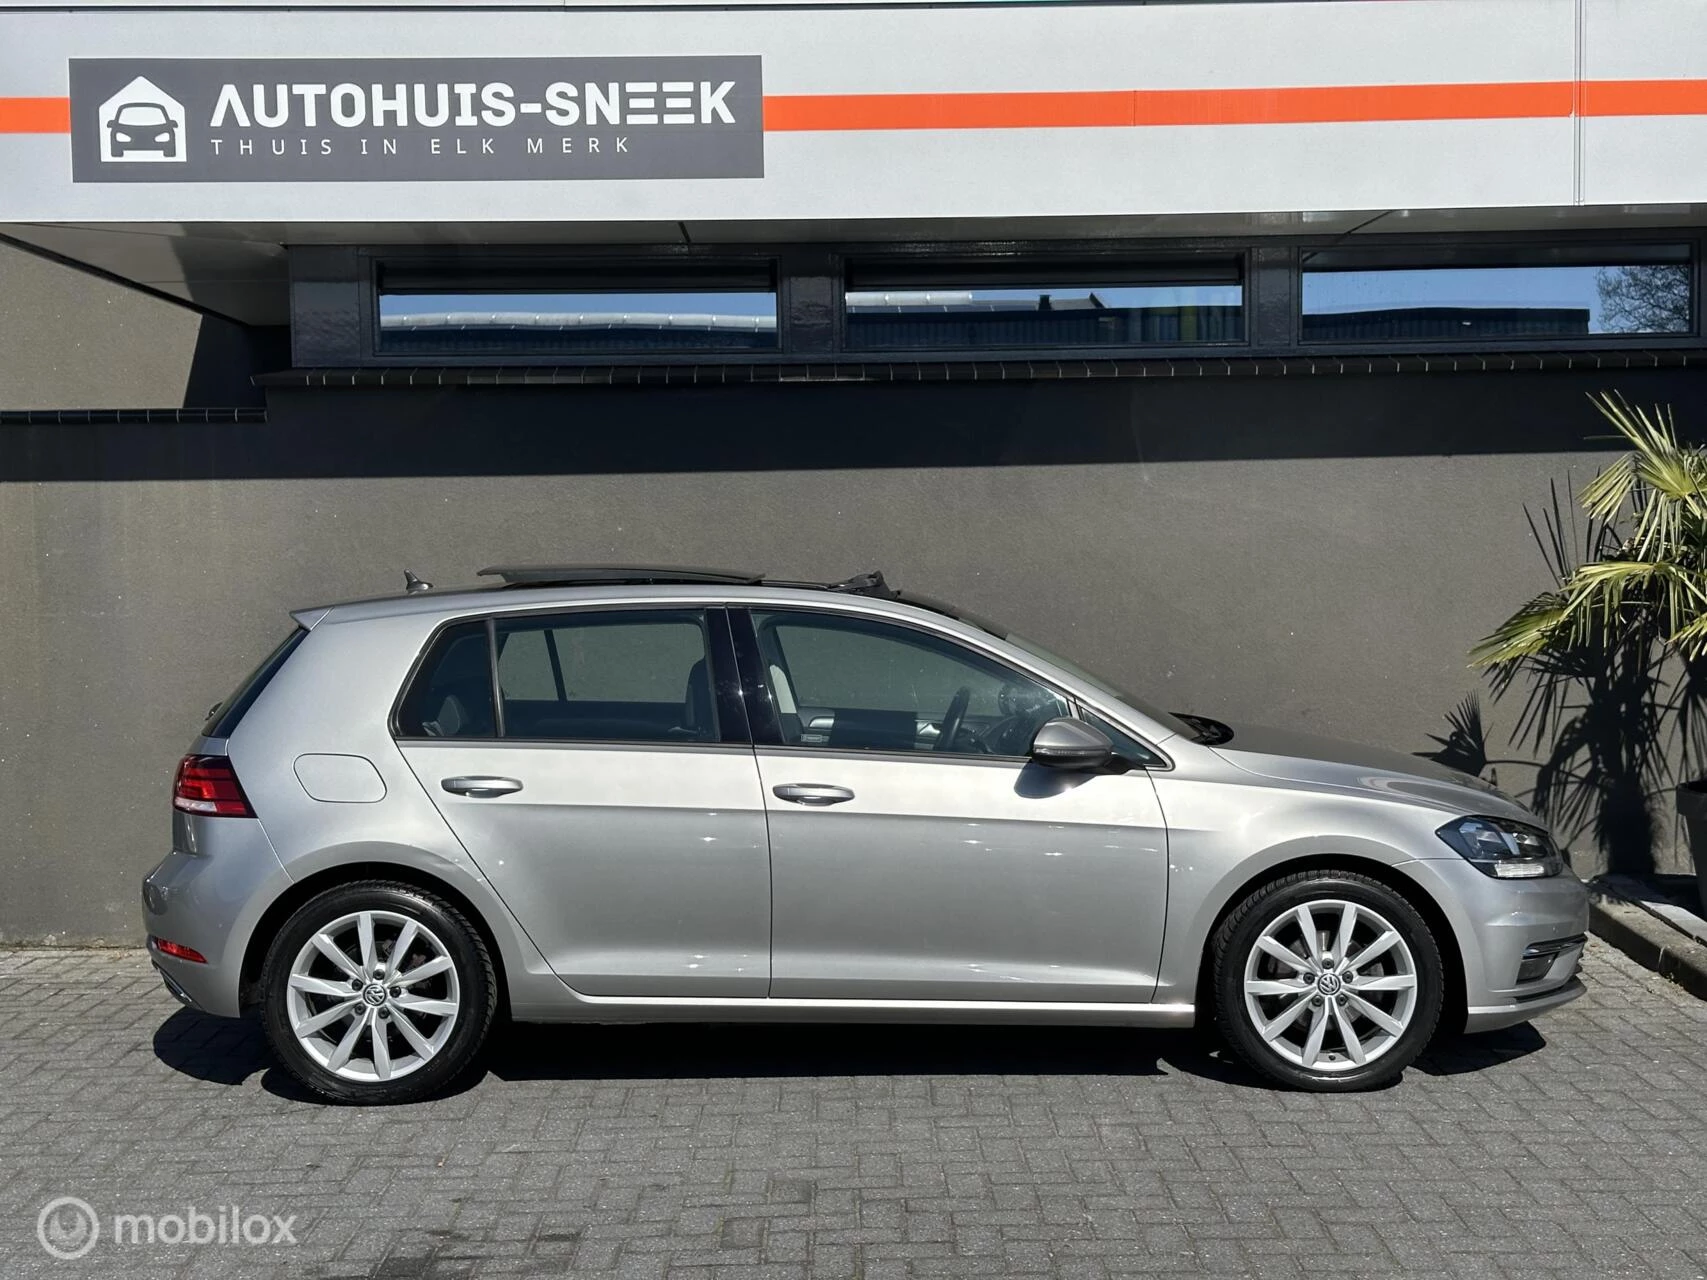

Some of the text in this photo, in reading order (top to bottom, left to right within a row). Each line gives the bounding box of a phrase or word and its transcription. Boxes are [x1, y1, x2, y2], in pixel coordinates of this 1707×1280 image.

[209, 80, 736, 128] AUTOHUIS-SNEEK
[210, 136, 628, 156] THUIS IN ELK MERK
